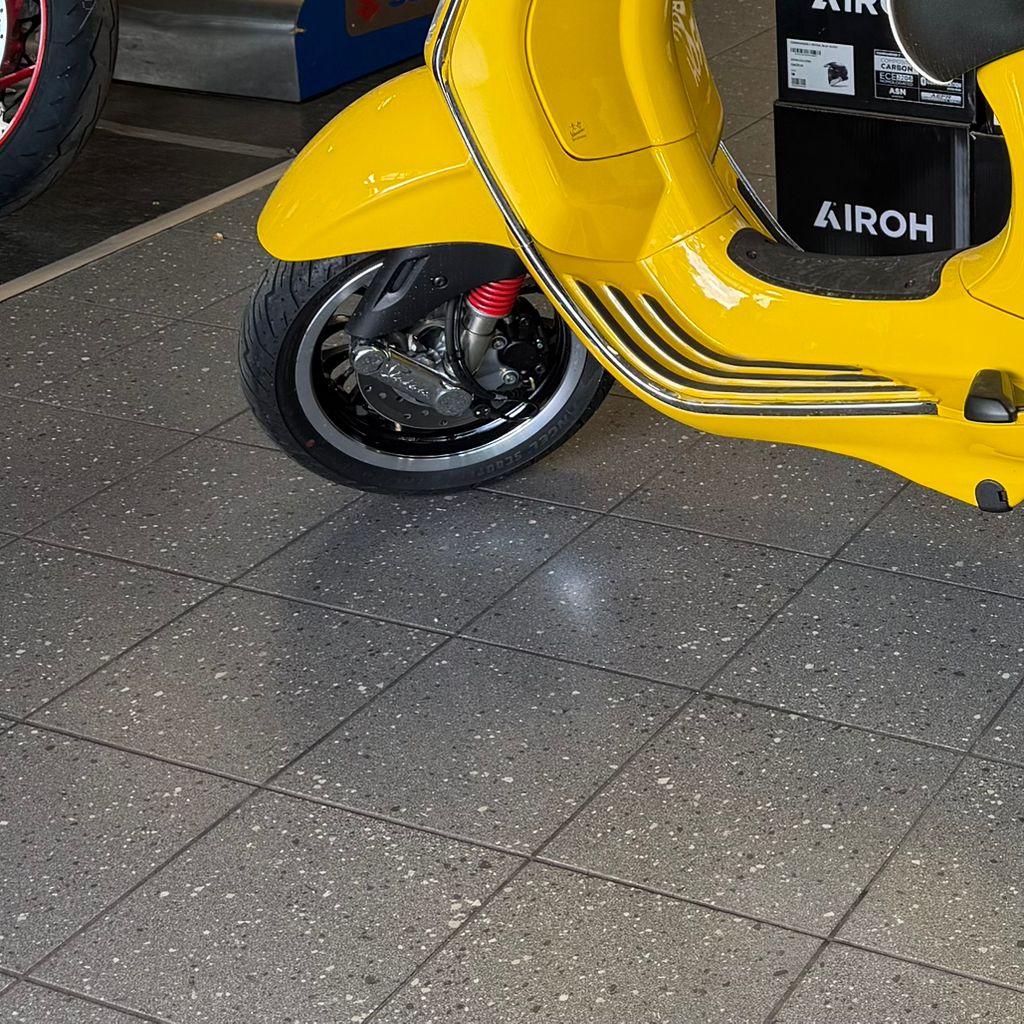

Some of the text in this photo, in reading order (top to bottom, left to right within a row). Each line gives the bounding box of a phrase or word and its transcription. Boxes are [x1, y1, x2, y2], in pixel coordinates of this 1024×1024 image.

[880, 63, 914, 72] CARBON
[888, 87, 907, 96] ASN
[814, 200, 934, 243] AIROH
